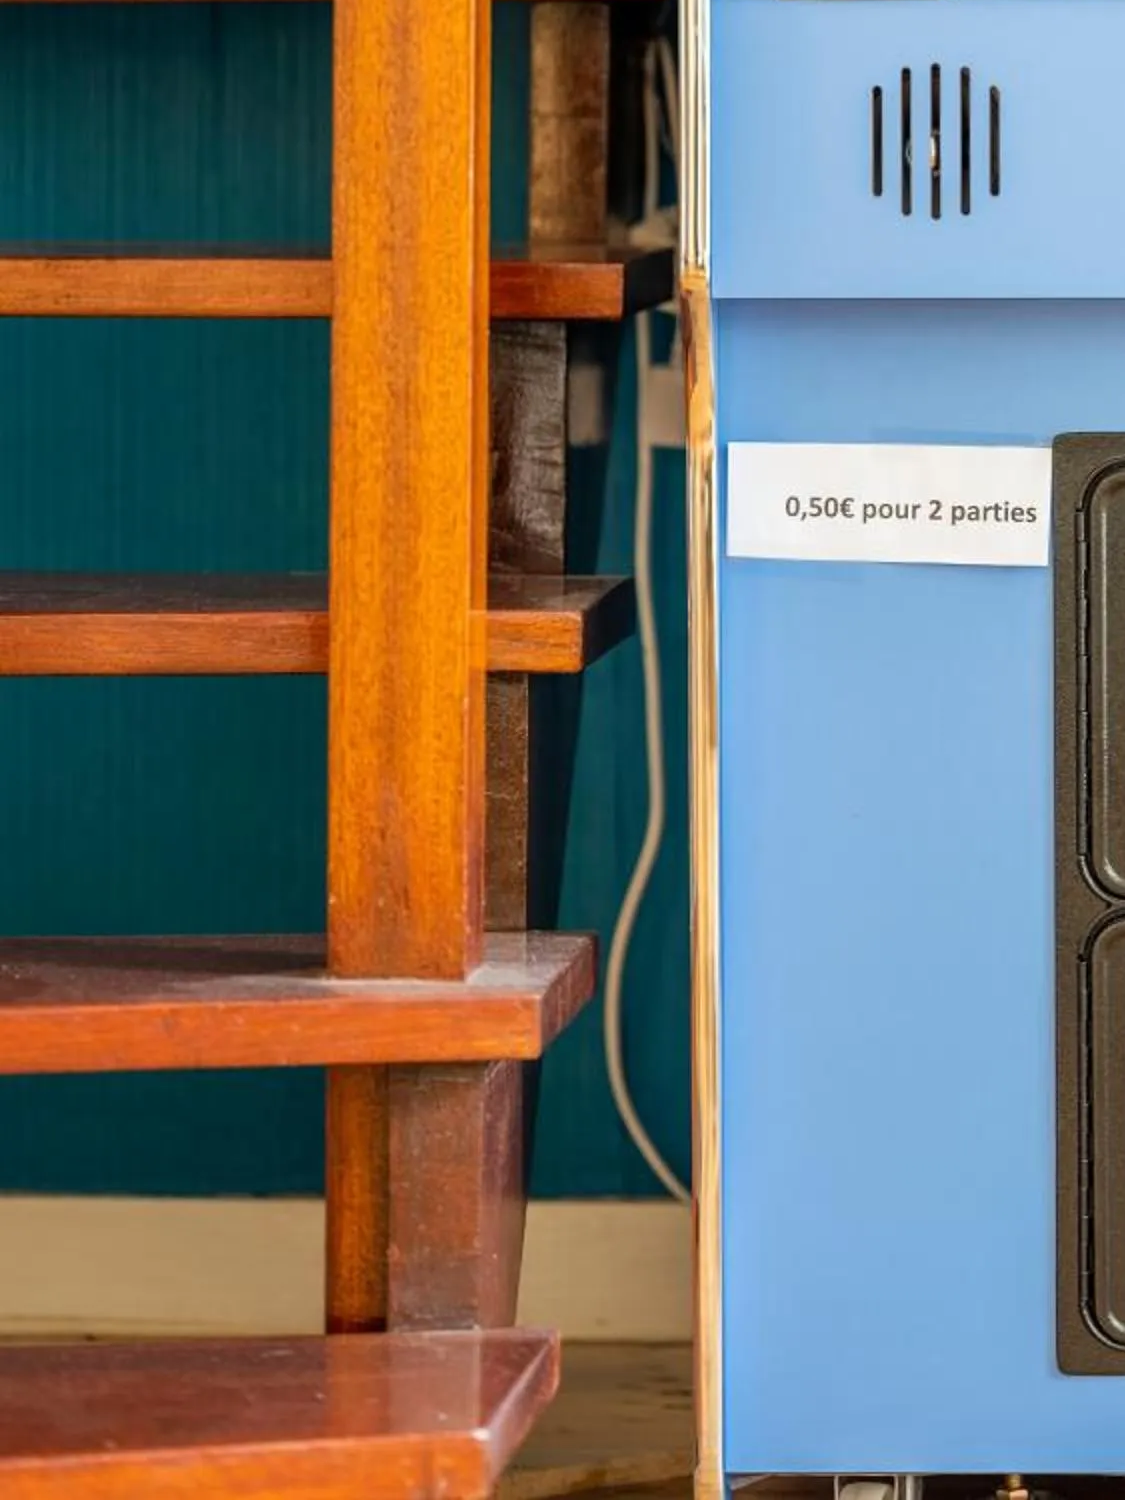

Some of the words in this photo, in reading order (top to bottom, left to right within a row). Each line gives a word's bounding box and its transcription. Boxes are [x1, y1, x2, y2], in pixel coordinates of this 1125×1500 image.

[785, 496, 855, 521] 0,50€
[862, 504, 922, 523] pour
[928, 500, 943, 520] 2
[951, 501, 1037, 524] parties
